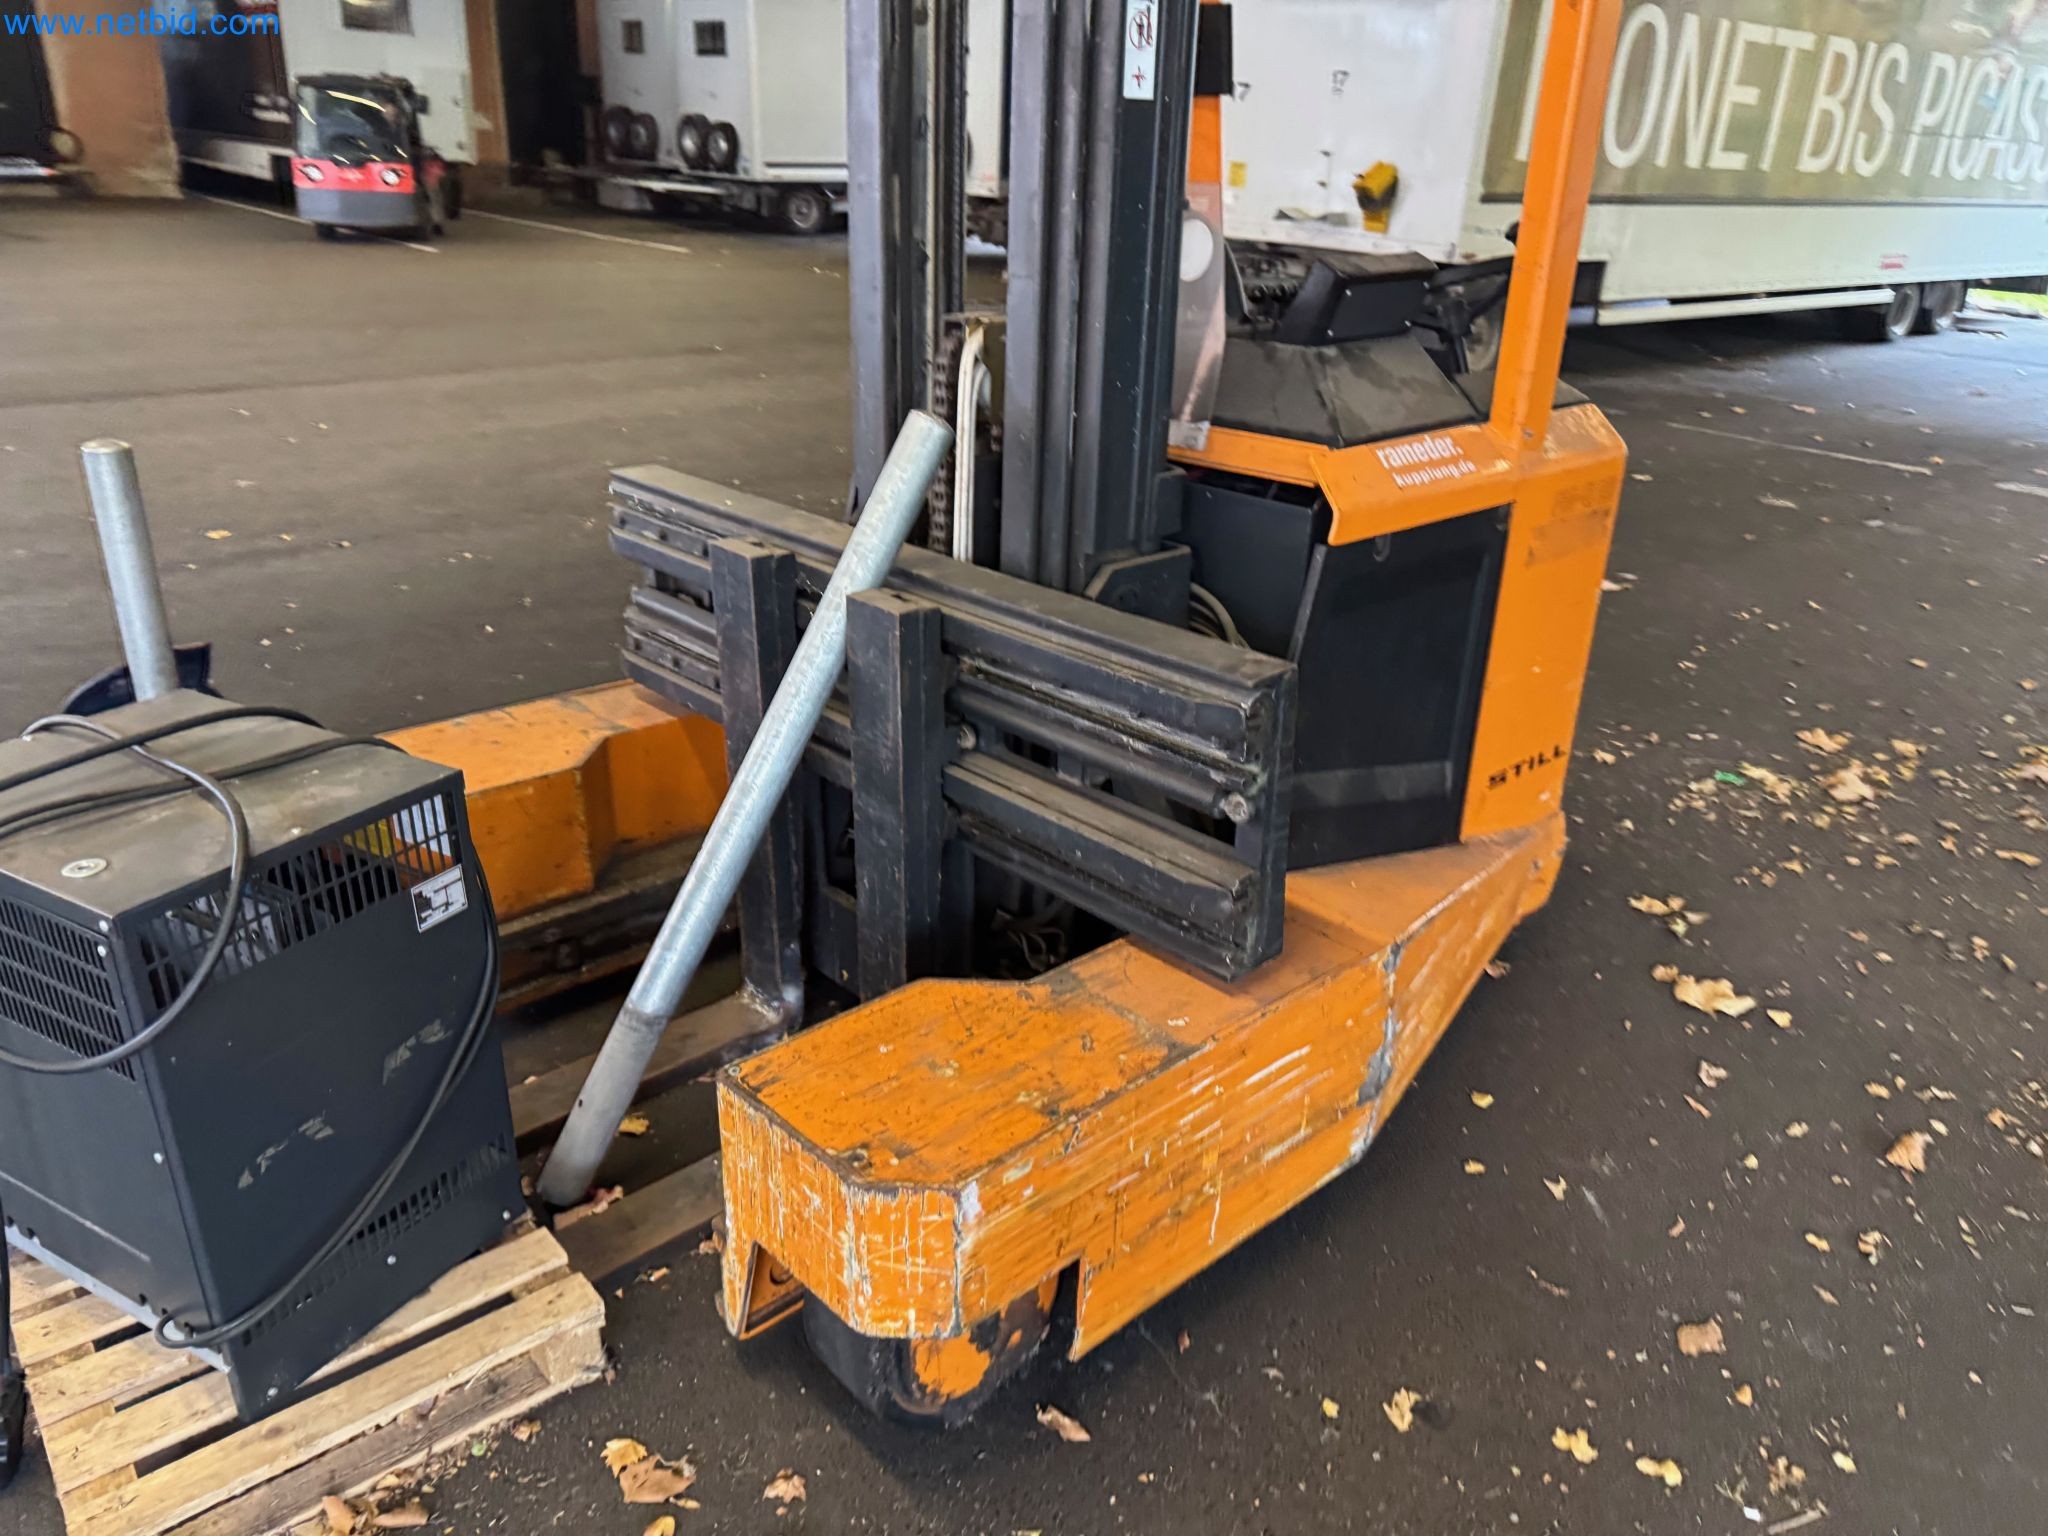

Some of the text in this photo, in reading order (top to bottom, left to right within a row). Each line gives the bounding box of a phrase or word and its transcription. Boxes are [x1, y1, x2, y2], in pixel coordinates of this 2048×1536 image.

[1797, 34, 1909, 178] BIS
[1392, 458, 1477, 487] kupplung.de
[1486, 745, 1567, 791] STILL
